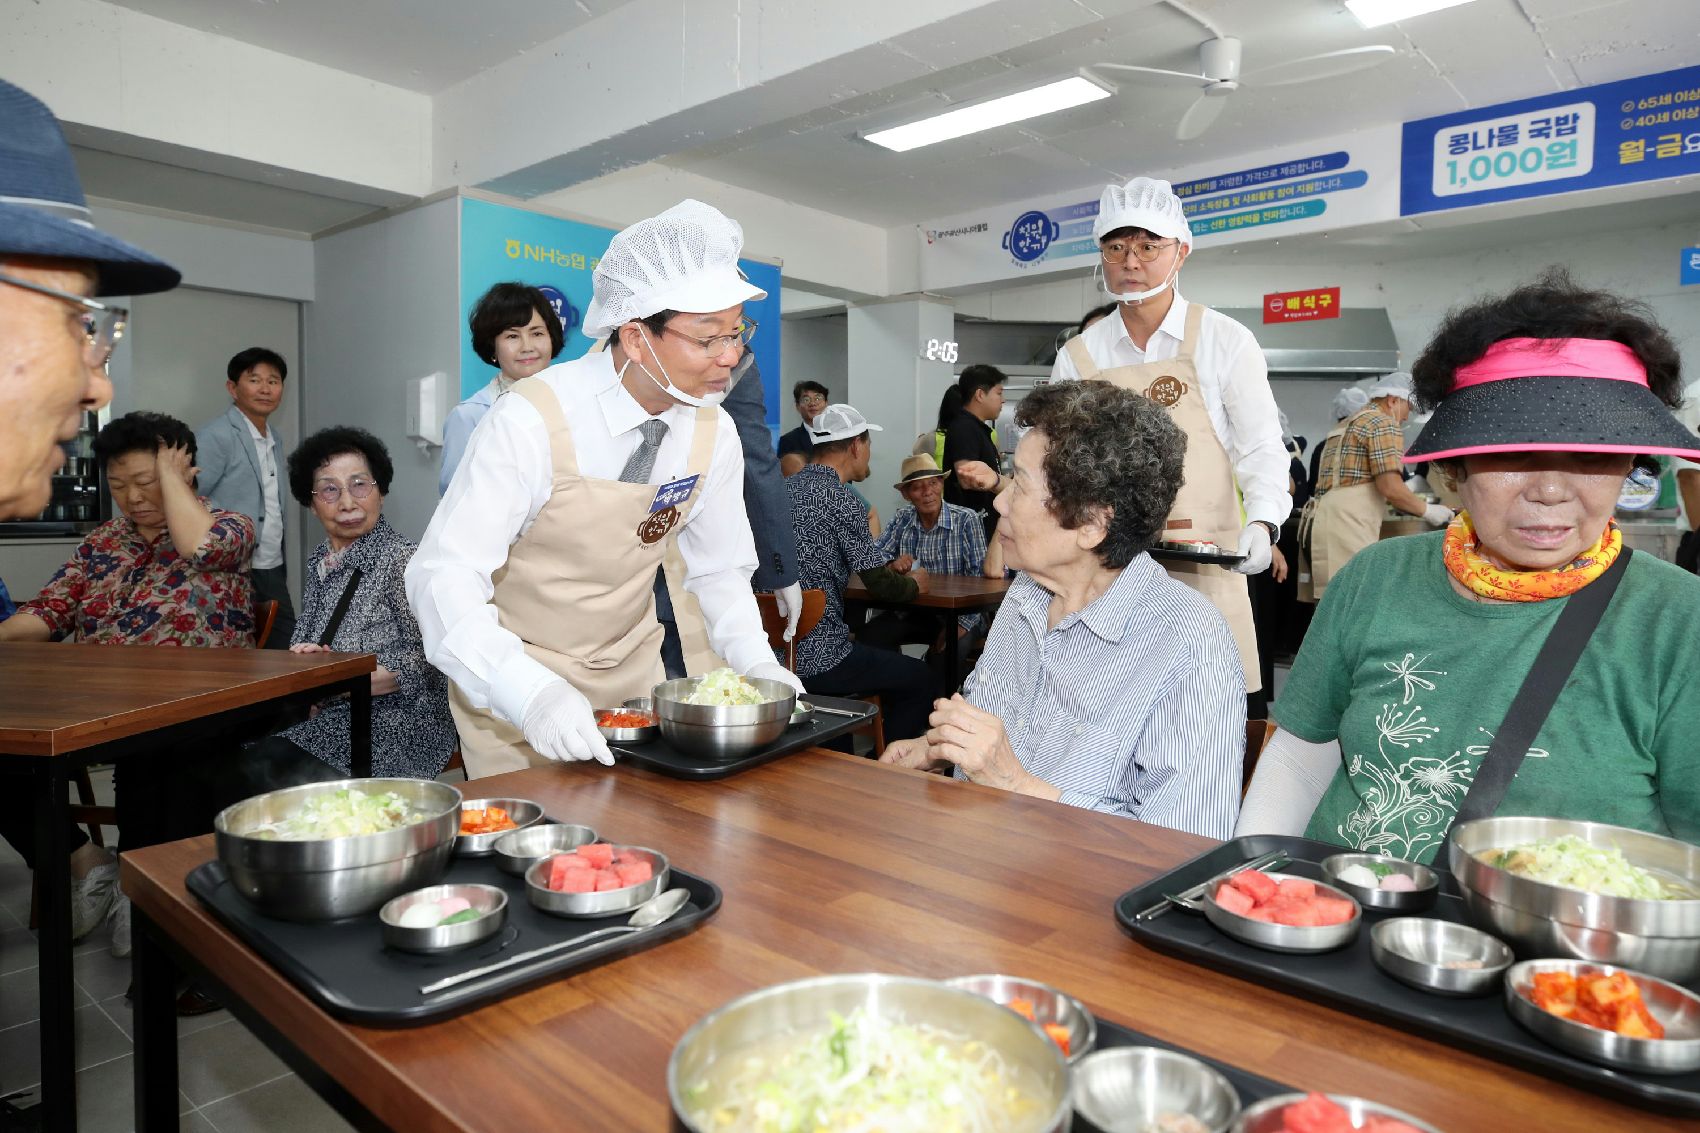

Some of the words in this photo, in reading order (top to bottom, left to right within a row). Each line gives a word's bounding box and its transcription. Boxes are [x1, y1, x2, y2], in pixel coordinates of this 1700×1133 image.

[1638, 93, 1672, 109] 65세
[1635, 111, 1670, 127] 40세
[1448, 124, 1520, 156] 콩나물
[1528, 112, 1581, 140] 국밥
[1244, 168, 1278, 183] 가격으로
[1280, 159, 1326, 176] 제공합니다.
[1446, 138, 1579, 188] 1,000원
[524, 243, 585, 271] NH농협
[1286, 294, 1332, 310] 배식구
